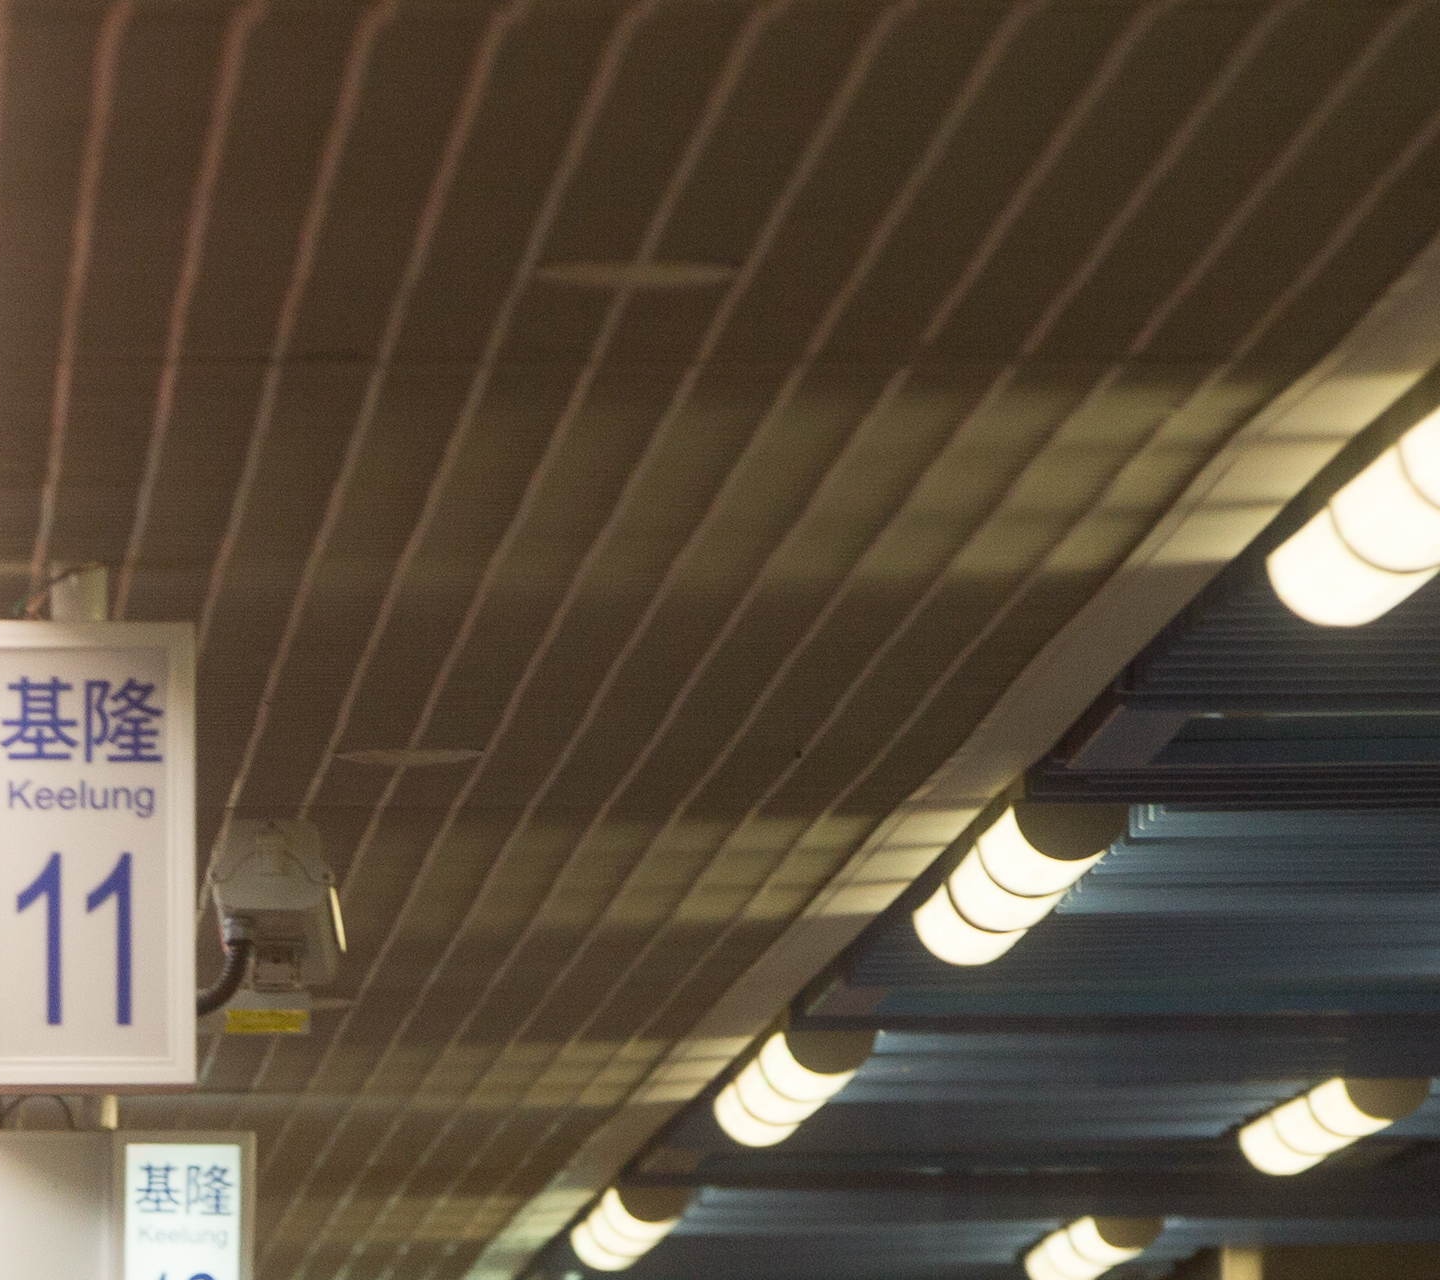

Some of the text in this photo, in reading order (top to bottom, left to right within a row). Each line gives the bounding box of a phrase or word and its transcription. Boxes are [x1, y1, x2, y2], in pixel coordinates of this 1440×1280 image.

[0, 676, 165, 764] 基隆
[7, 780, 156, 818] Keelung
[15, 851, 133, 1027] 11
[135, 1162, 235, 1217] 基隆
[138, 1225, 229, 1248] Keelung
